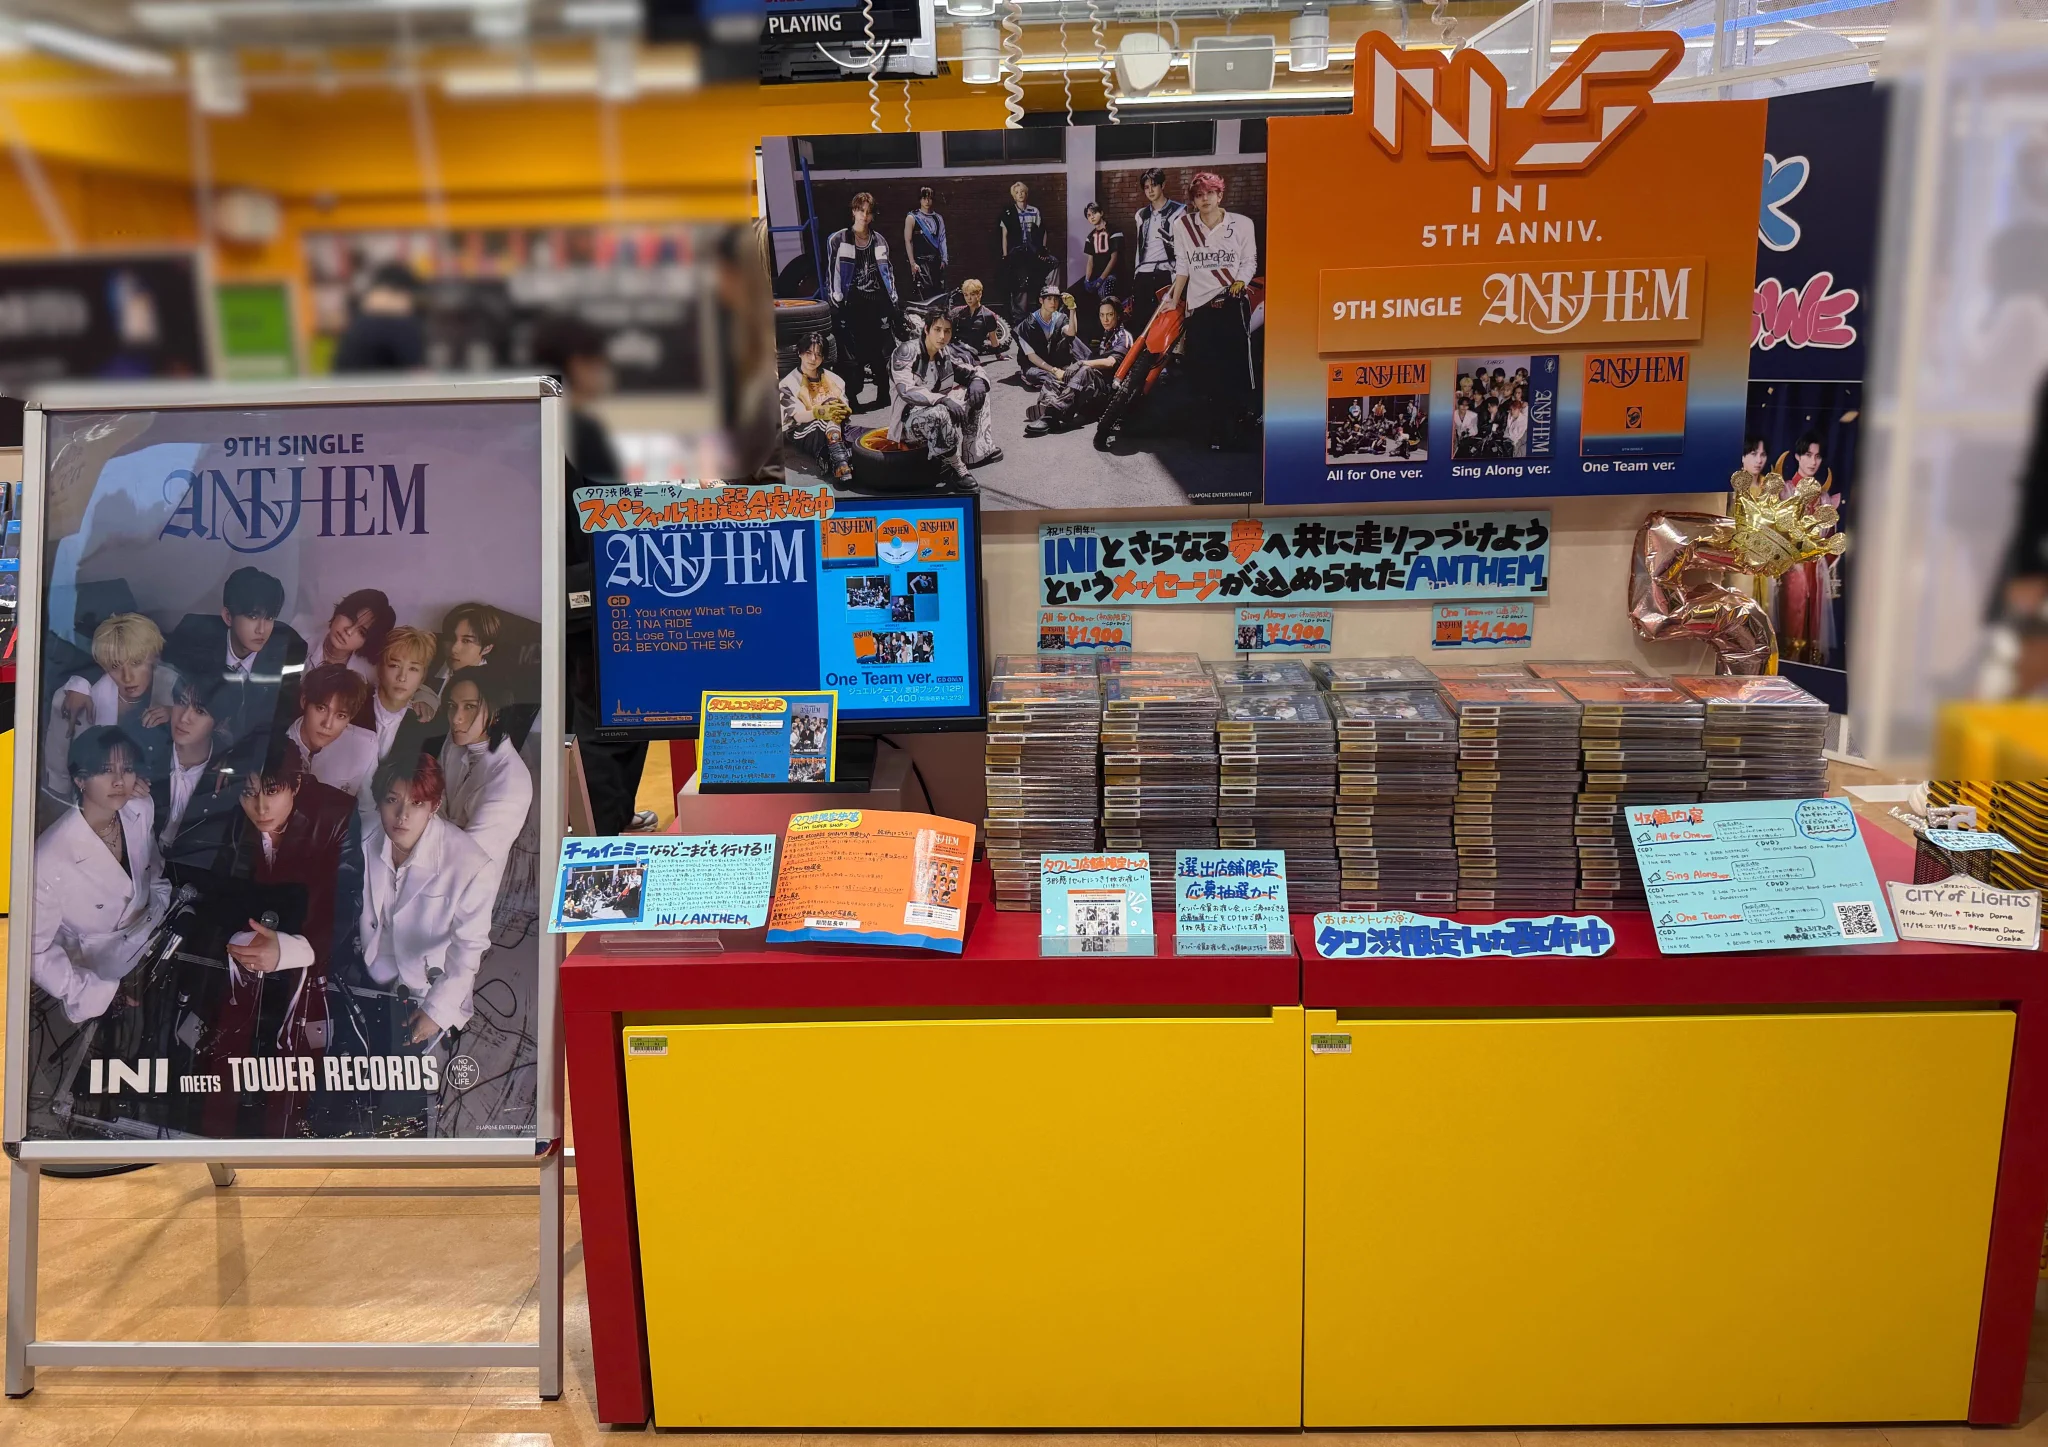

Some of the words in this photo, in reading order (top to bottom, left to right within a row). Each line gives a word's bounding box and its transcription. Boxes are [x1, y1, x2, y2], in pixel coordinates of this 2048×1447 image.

[769, 15, 842, 34] PLAYING
[1471, 184, 1547, 214] INI
[1421, 223, 1480, 248] 5TH
[1495, 219, 1603, 246] ANNIV.
[1092, 230, 1110, 254] 10
[1332, 299, 1377, 321] 9TH
[1381, 296, 1462, 320] SINGLE
[1478, 267, 1693, 335] ANTHEM
[1354, 363, 1427, 389] ANTHEM
[1586, 355, 1685, 389] ANTHEM
[1531, 389, 1553, 454] ANTHEM
[223, 437, 271, 457] 9TH
[278, 433, 365, 456] SINGLE
[1451, 466, 1485, 479] Sing
[1487, 464, 1524, 479] Along
[1526, 466, 1552, 477] ver.
[1582, 462, 1609, 473] One
[1612, 461, 1649, 473] Team
[1652, 461, 1676, 472] ver.
[1327, 470, 1347, 481] All
[1350, 469, 1369, 481] for
[1371, 469, 1397, 480] One
[1399, 469, 1424, 480] ver.
[158, 462, 430, 554] ANTHEM
[578, 486, 834, 531] スペシャル抽選会実施中
[828, 519, 873, 536] ANTHEM
[882, 525, 910, 535] ANTHEM
[919, 521, 955, 534] ANTHEM
[605, 528, 808, 598] ANTHEM
[610, 597, 628, 605] CD
[611, 608, 632, 618] 01.
[635, 608, 657, 618] You
[660, 607, 692, 617] Know
[695, 606, 725, 616] What
[729, 605, 743, 615] To
[746, 605, 762, 615] Do
[1041, 613, 1053, 624] All
[1057, 613, 1067, 622] for
[1069, 612, 1085, 622] One
[1241, 610, 1260, 622] Sing
[1263, 609, 1286, 620] Along
[1441, 607, 1459, 618] One
[1462, 607, 1483, 616] Team
[612, 620, 632, 630] 02.
[636, 619, 661, 629] 1NA
[665, 619, 692, 629] RIDE
[612, 631, 633, 641] 03.
[635, 631, 665, 641] Lose
[668, 630, 683, 640] To
[686, 629, 714, 640] Love
[718, 628, 735, 638] Me
[613, 643, 633, 653] 04.
[636, 642, 688, 652] BEYOND
[691, 641, 716, 651] THE
[719, 640, 743, 650] SKY
[825, 672, 858, 686] One
[861, 671, 903, 685] Team
[907, 671, 935, 685] ver.
[848, 686, 898, 696] ジュエルケース
[882, 694, 918, 703] ¥1,400
[1633, 807, 1704, 824] 収録内容
[1656, 832, 1668, 841] All
[1670, 831, 1681, 839] for
[1683, 830, 1701, 839] One
[1178, 856, 1279, 878] 選出店舗限定
[1666, 870, 1690, 880] Sing
[1693, 869, 1717, 879] Along
[1186, 880, 1279, 900] 応募抽選カード
[1905, 888, 1946, 902] CITY
[1947, 889, 1967, 903] of
[1971, 888, 2032, 907] LIGHTS
[656, 914, 677, 926] INI
[691, 912, 749, 925] ANTHEM
[1676, 913, 1698, 923] One
[1700, 911, 1727, 920] Team
[1989, 912, 2014, 920] Dome
[1316, 916, 1611, 957] タワ渋限定トレカ配布中
[2003, 926, 2026, 934] Dome
[89, 1057, 169, 1094] INI
[180, 1075, 222, 1093] MEETS
[227, 1056, 317, 1093] TOWER
[323, 1055, 440, 1092] RECORDS
[451, 1064, 476, 1072] MUSIC.
